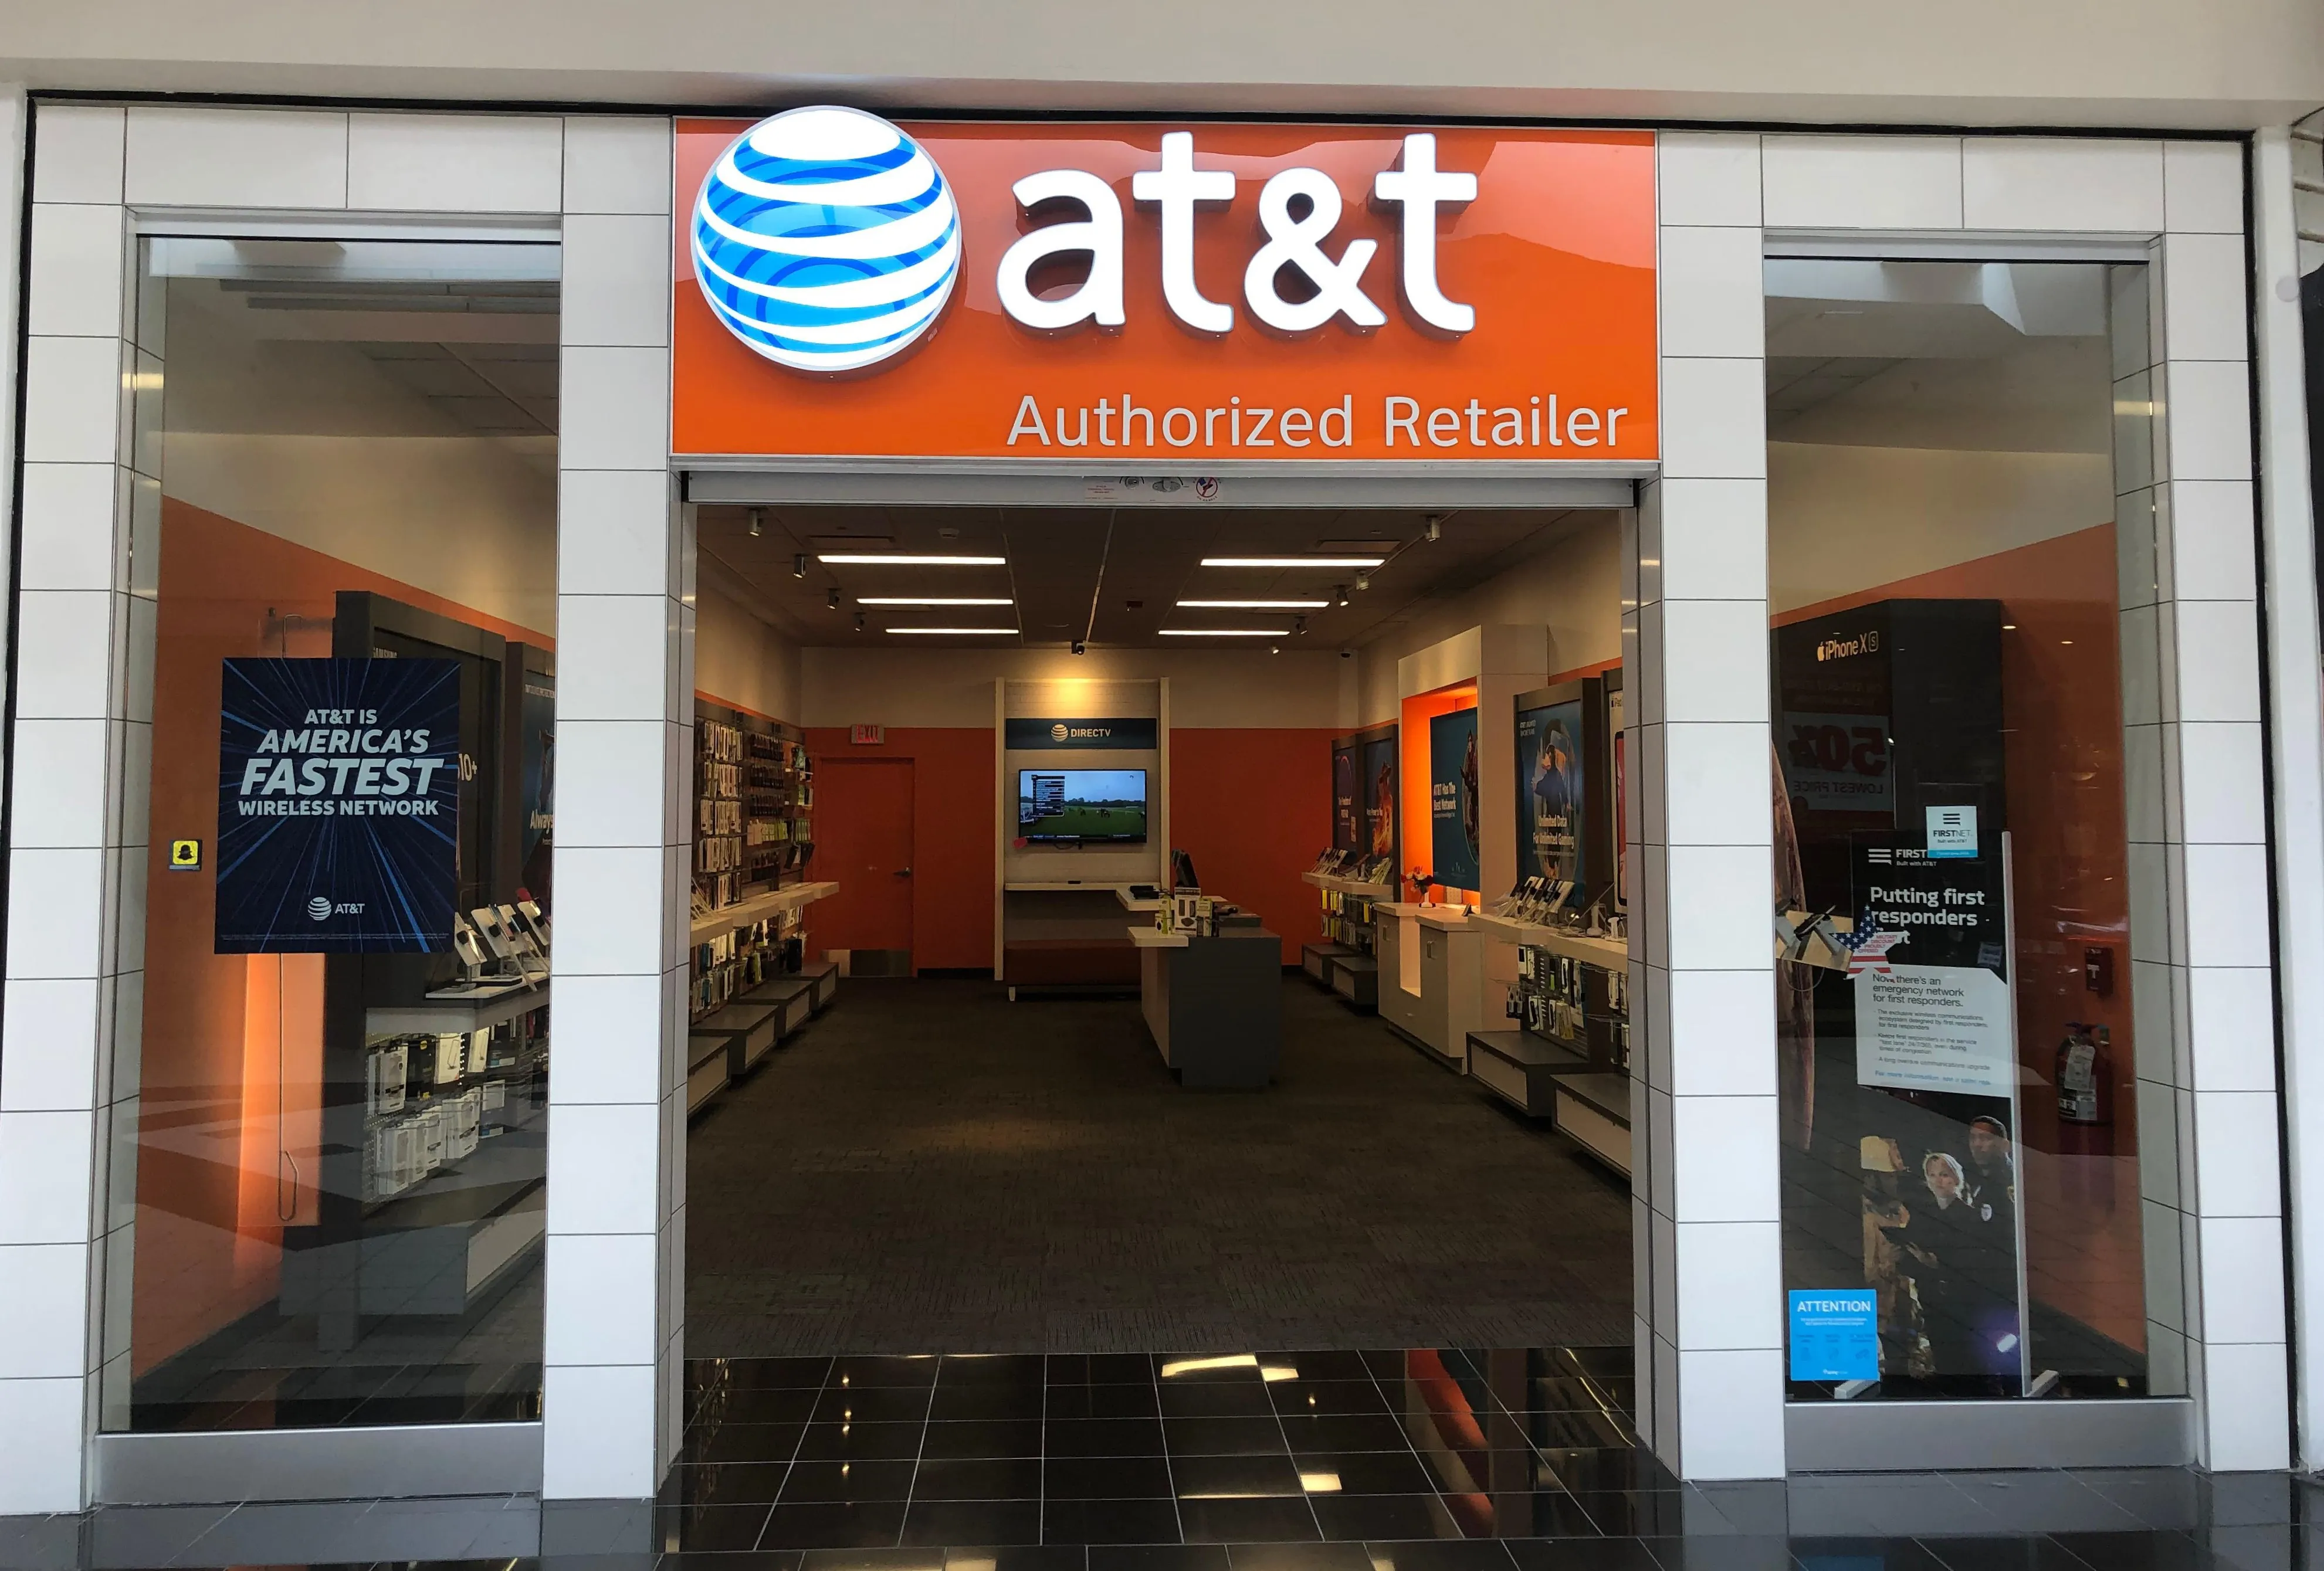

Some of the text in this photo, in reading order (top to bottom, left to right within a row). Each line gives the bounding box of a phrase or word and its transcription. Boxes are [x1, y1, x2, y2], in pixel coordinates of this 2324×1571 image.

[997, 131, 1477, 334] at&t
[1006, 394, 1628, 447] Authorized Retailer
[1825, 639, 1859, 660] iPhone
[304, 708, 377, 725] AT&T IS
[257, 729, 431, 754] AMERICA'S
[856, 725, 880, 744] EXIT
[1070, 728, 1111, 738] DIRECTV
[458, 753, 477, 781] 10+
[240, 758, 445, 795] FASTEST
[238, 800, 439, 816] WIRELESS NETWORK
[1896, 849, 1927, 858] FIRST
[1871, 887, 1985, 907] Putting first
[335, 903, 365, 914] AT&T
[1871, 909, 1977, 927] responders
[1896, 975, 1926, 985] there's
[1873, 985, 1964, 996] emergency network
[1873, 994, 1963, 1007] for first responders.
[1797, 1300, 1871, 1312] ATTENTION
